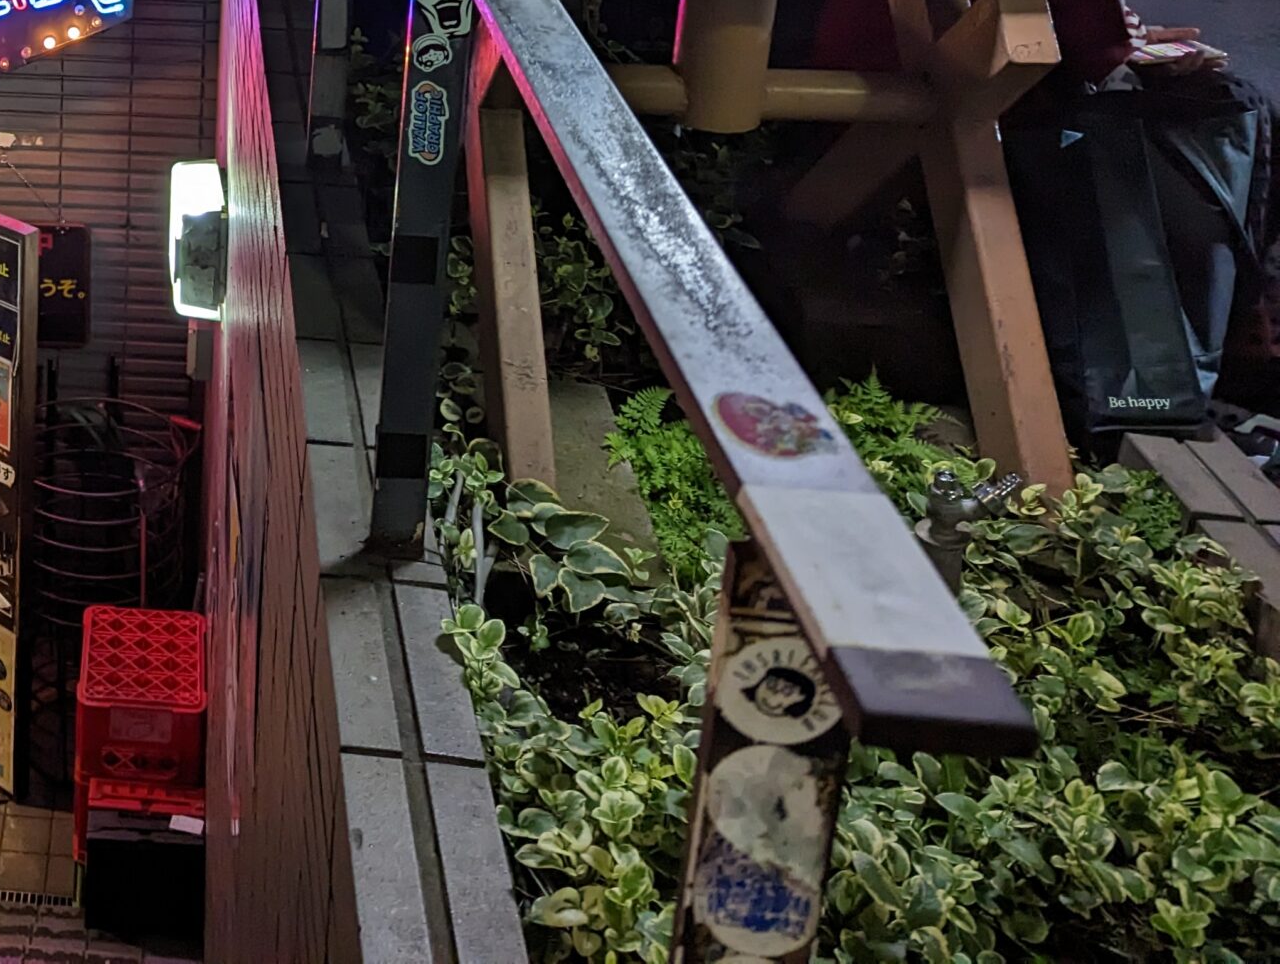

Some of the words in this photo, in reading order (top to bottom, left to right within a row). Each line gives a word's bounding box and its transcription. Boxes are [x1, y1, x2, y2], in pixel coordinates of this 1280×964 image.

[427, 90, 443, 154] GRAPHIC
[1108, 396, 1127, 409] Be
[1128, 397, 1171, 411] happy
